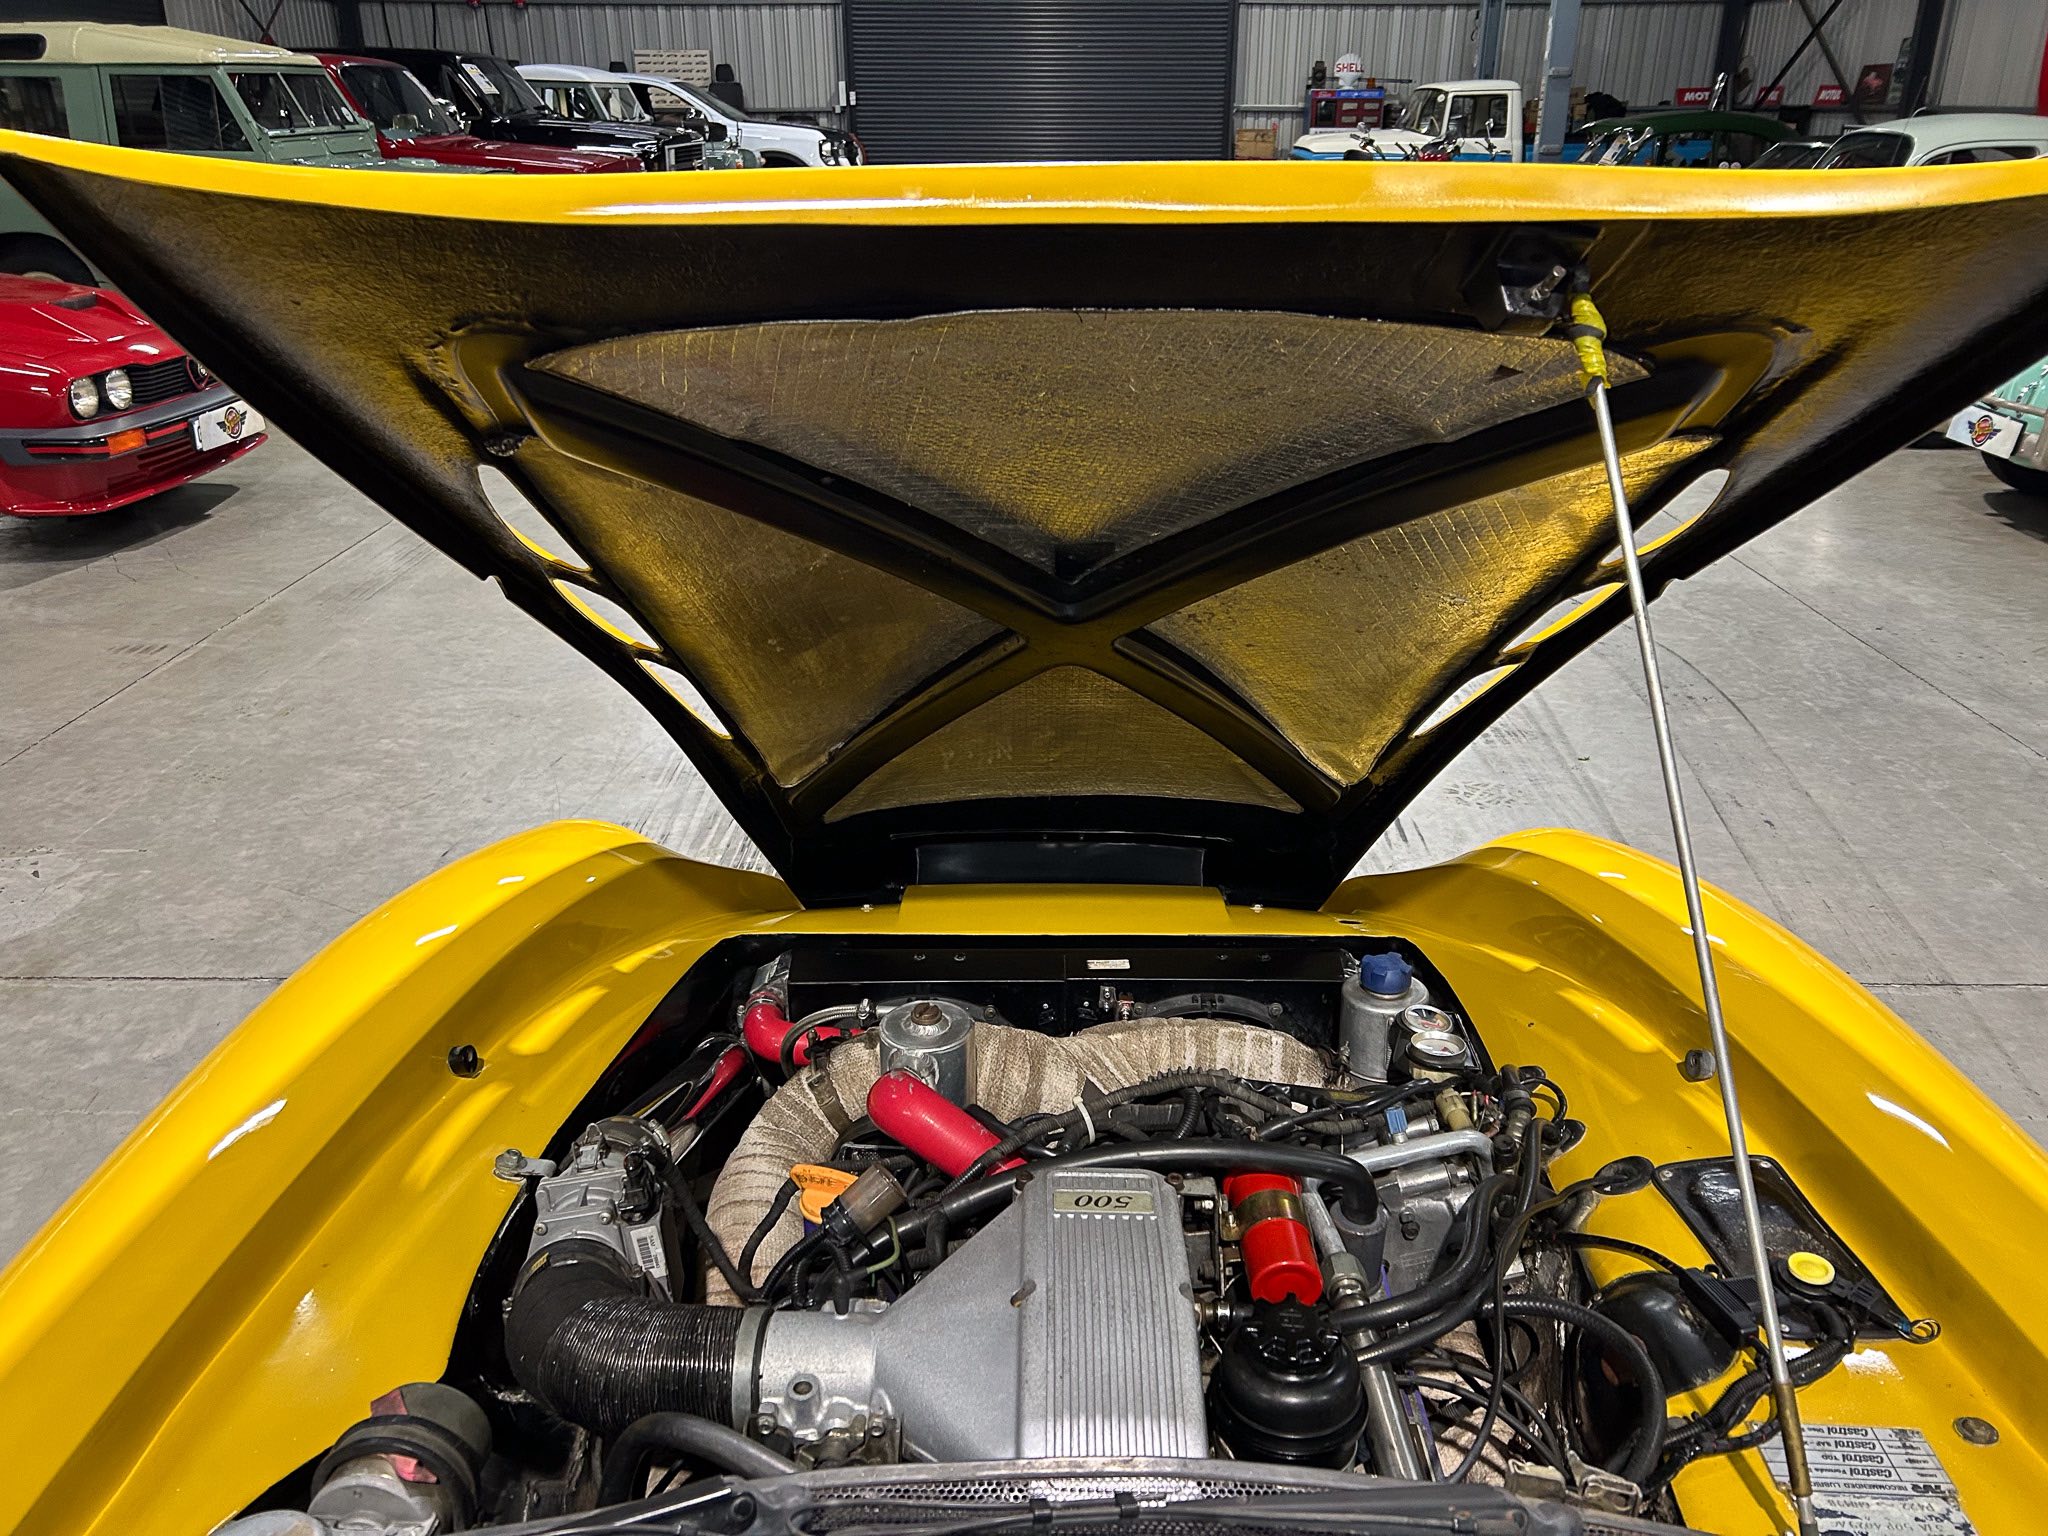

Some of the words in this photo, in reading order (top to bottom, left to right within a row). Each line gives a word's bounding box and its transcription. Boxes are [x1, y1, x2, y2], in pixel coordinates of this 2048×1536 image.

[1336, 63, 1365, 73] SHELL
[1684, 91, 1710, 101] MOT
[1074, 1195, 1133, 1208] 500
[1828, 1427, 1868, 1437] Castrol
[1834, 1440, 1876, 1451] Castrol
[1842, 1454, 1884, 1464] Castrol
[1849, 1468, 1892, 1478] Castrol
[1843, 1482, 1908, 1491] RECOMMENDED
[1911, 1484, 1946, 1494] TVR
